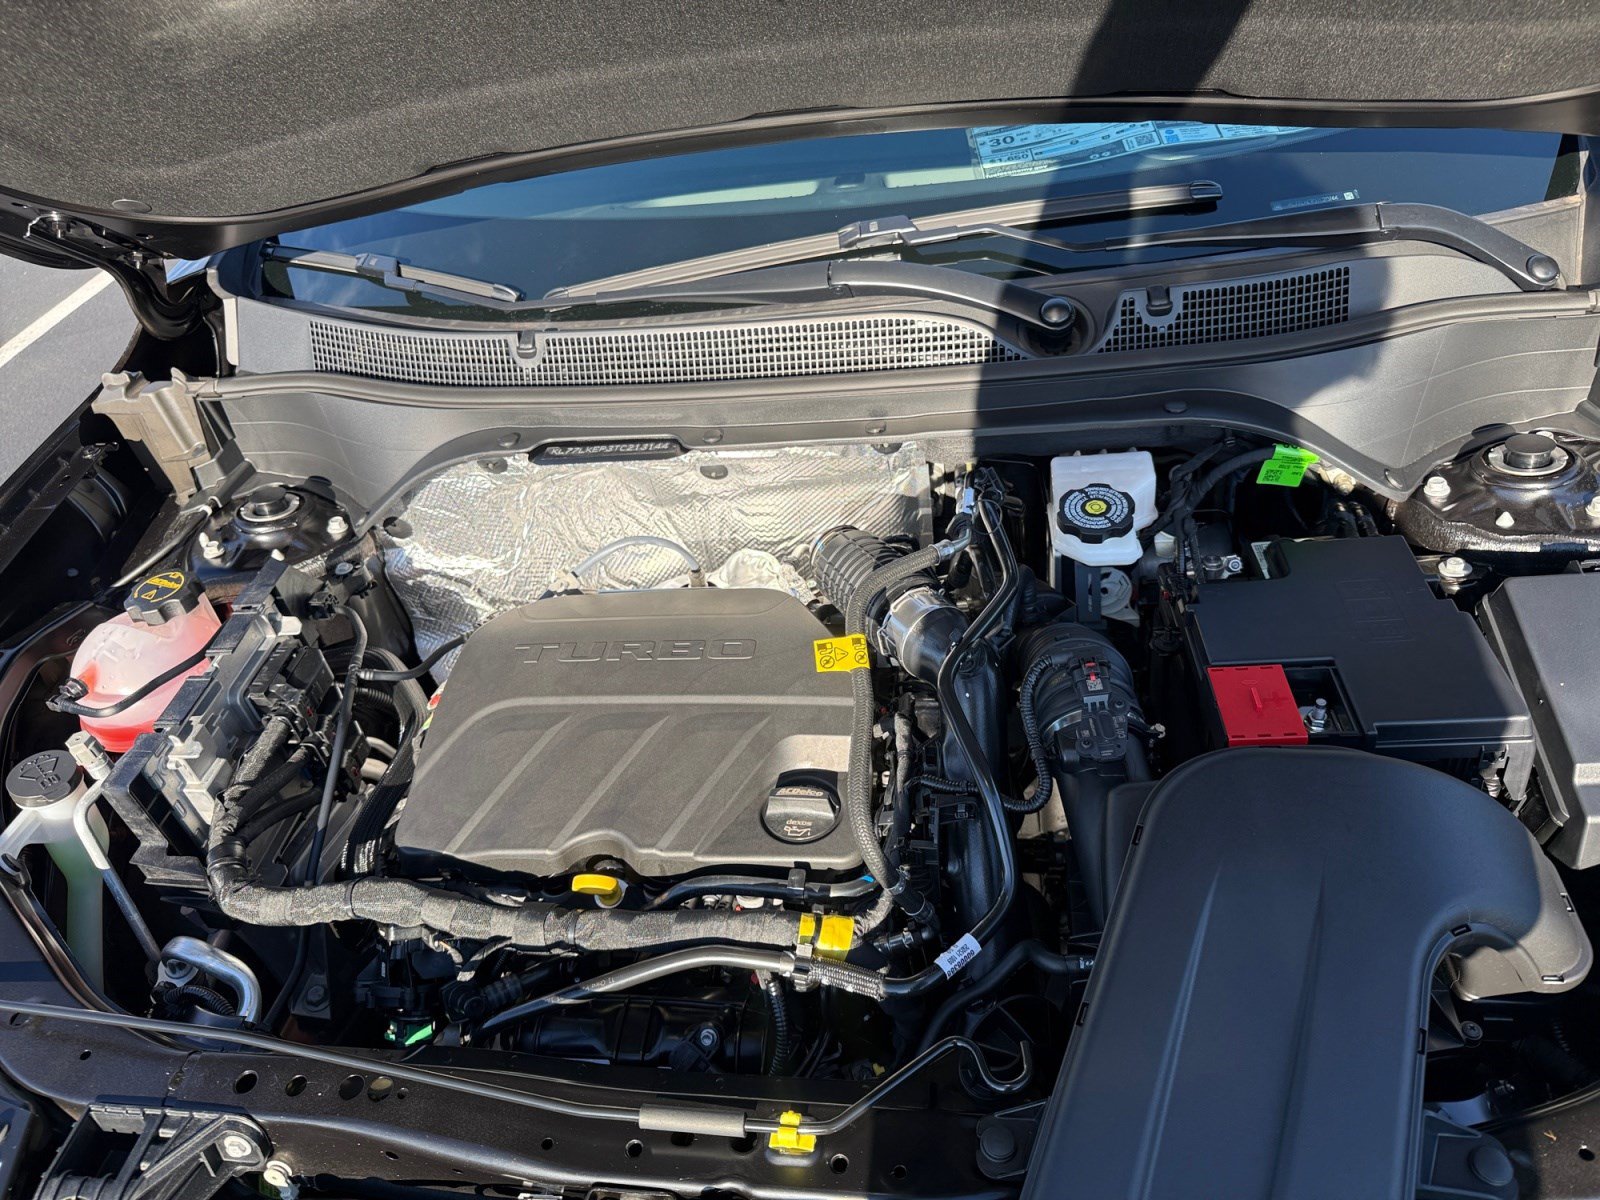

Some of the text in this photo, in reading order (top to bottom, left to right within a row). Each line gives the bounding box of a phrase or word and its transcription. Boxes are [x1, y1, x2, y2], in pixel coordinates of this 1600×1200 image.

[989, 136, 1015, 147] 30
[514, 639, 757, 663] TURBO
[776, 787, 824, 797] ACDelco
